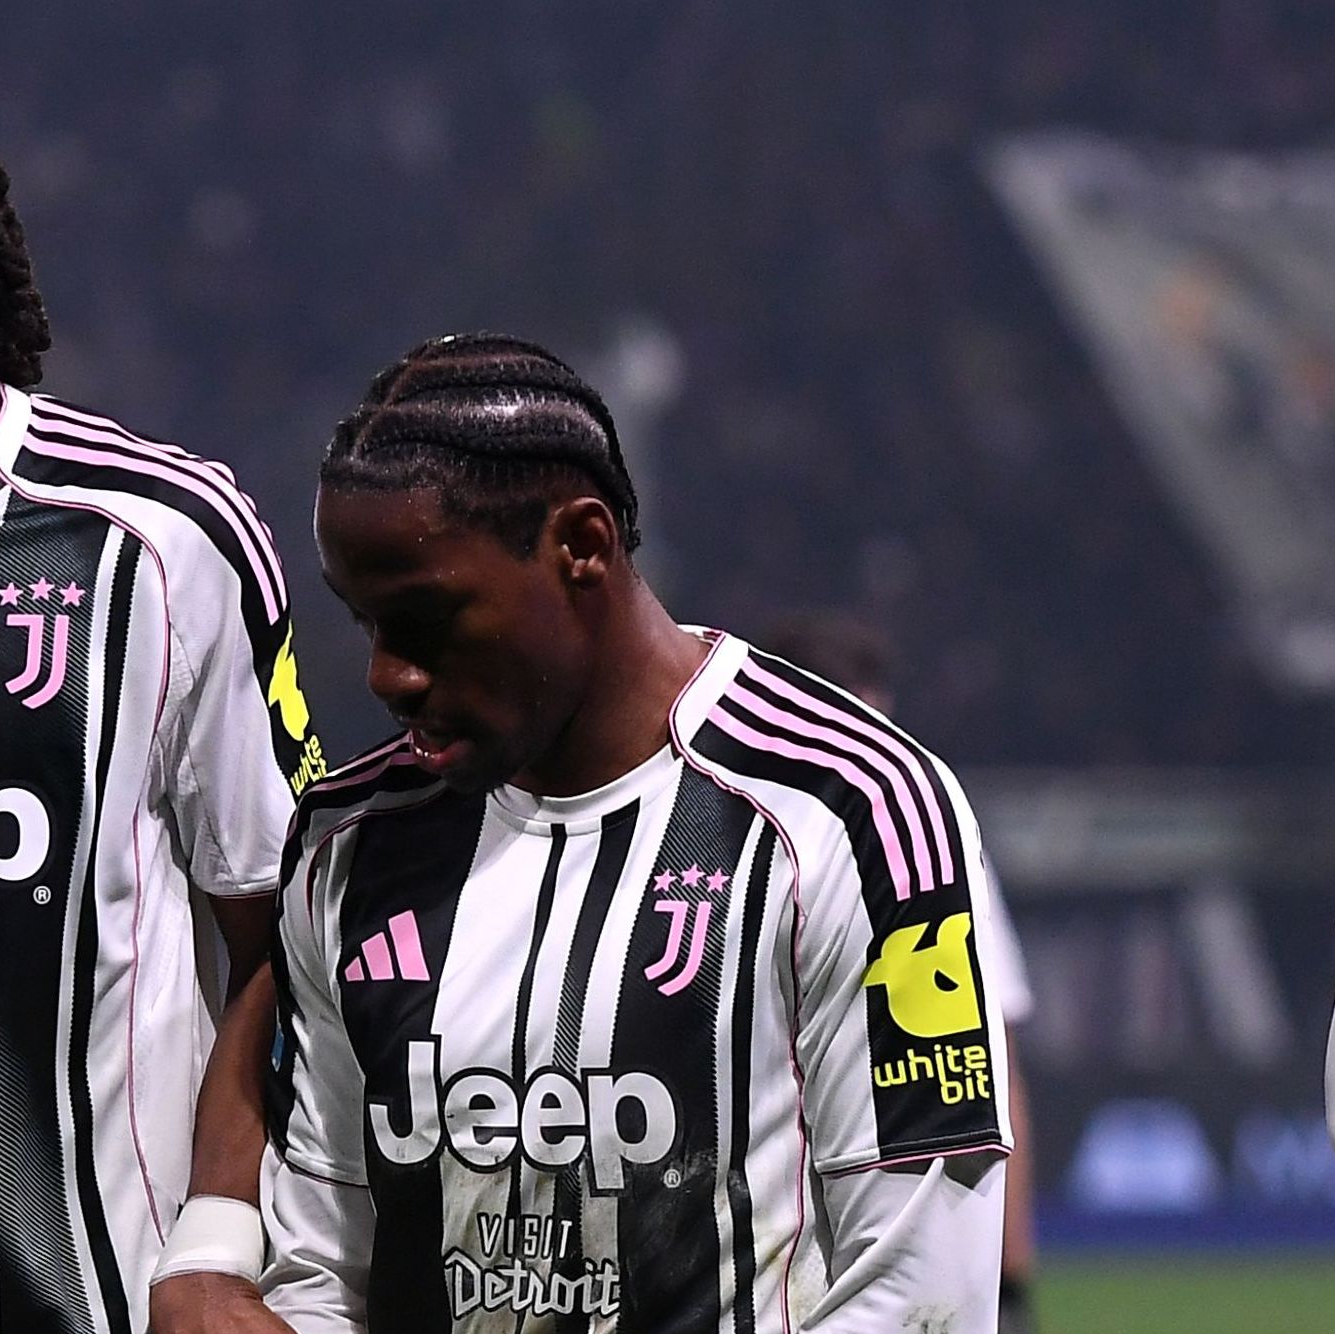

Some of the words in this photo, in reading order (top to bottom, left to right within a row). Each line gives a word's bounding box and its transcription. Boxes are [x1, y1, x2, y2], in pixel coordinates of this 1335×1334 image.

[873, 1044, 987, 1087] white
[940, 1068, 991, 1105] bit
[369, 1040, 677, 1189] Jeep
[479, 1214, 574, 1259] VISIT
[444, 1250, 621, 1319] Detroit
